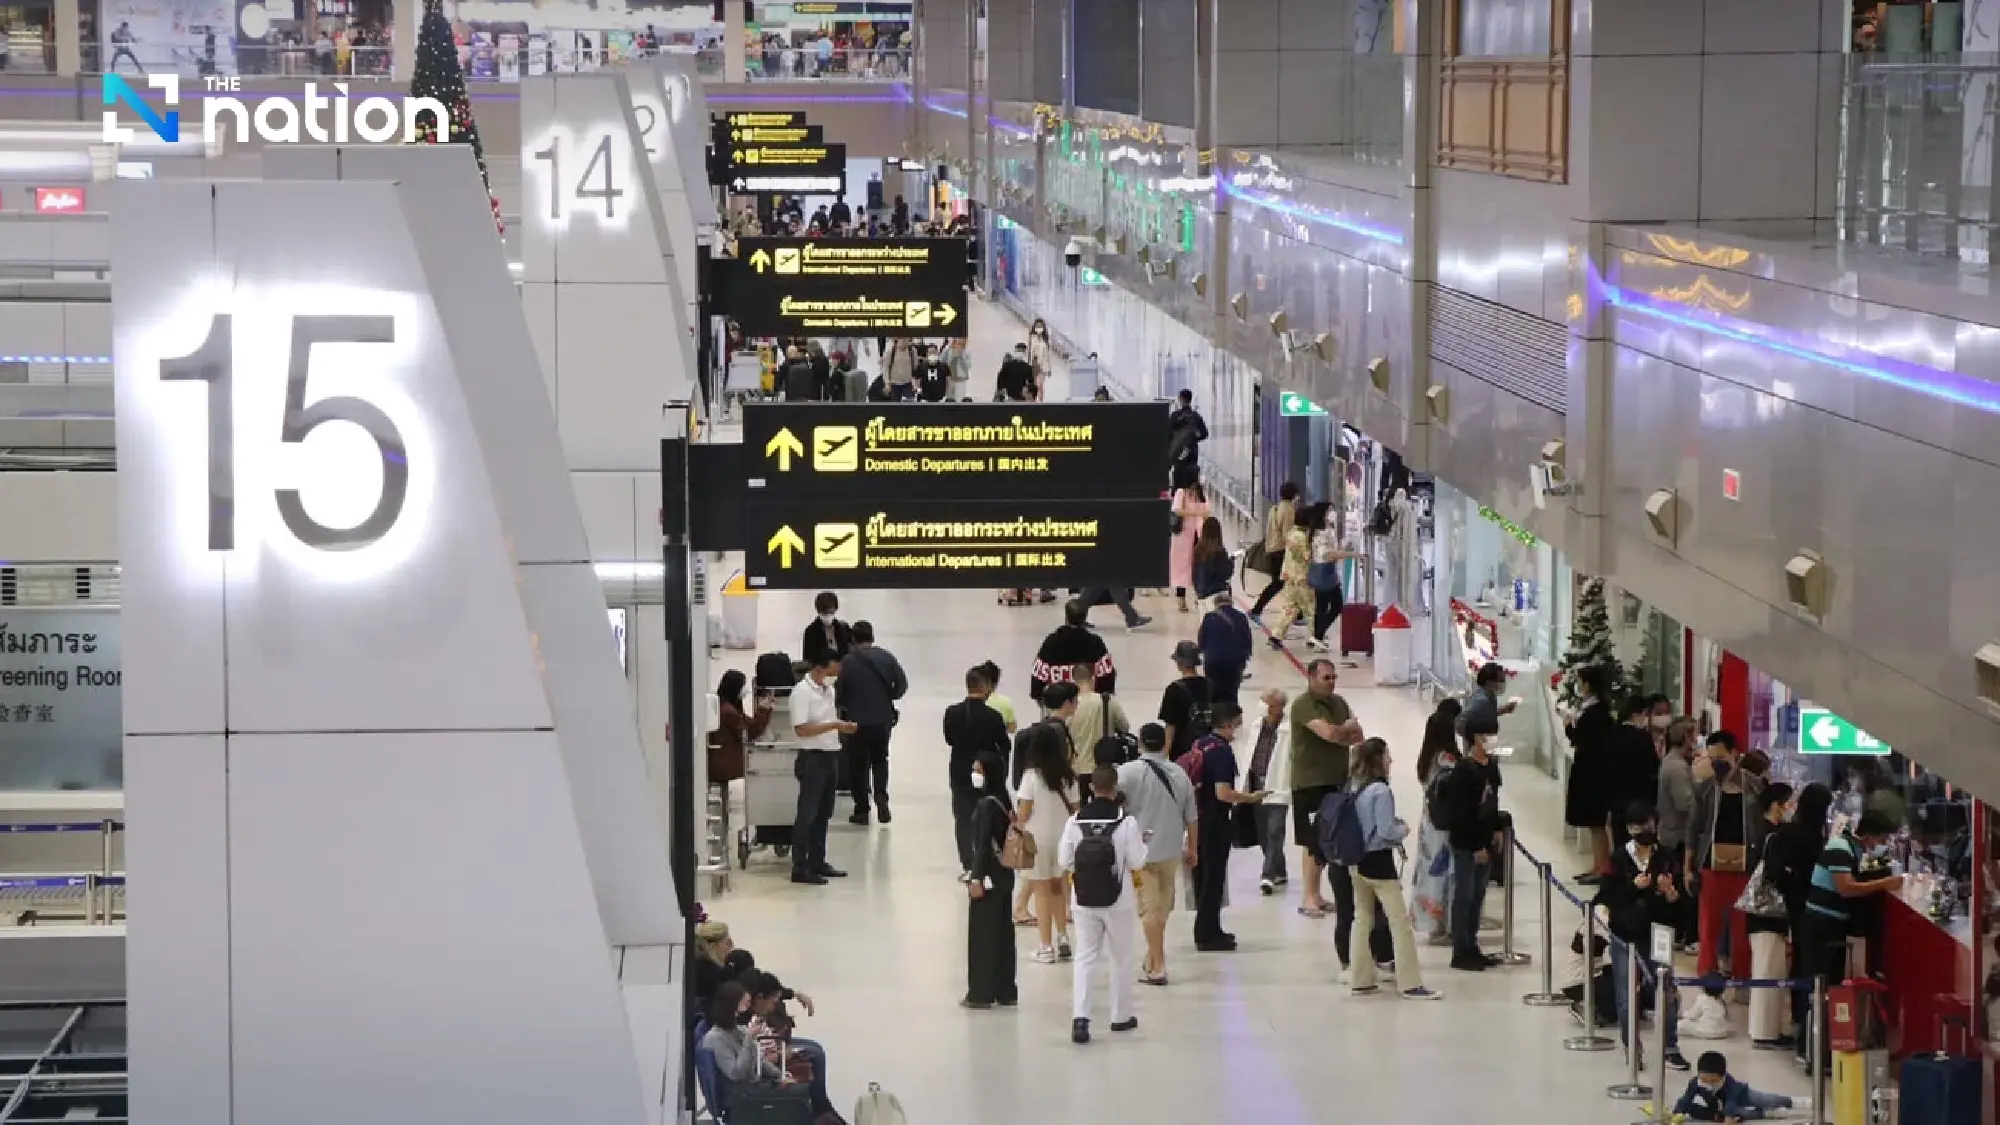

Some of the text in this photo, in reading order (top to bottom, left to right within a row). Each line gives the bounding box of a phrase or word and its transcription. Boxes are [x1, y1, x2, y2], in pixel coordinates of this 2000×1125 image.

[534, 134, 624, 219] 14
[159, 313, 409, 552] 15
[865, 458, 918, 471] Domestic
[921, 458, 986, 474] Departures
[865, 553, 936, 567] International
[938, 553, 1003, 569] Departures
[0, 665, 68, 691] eening
